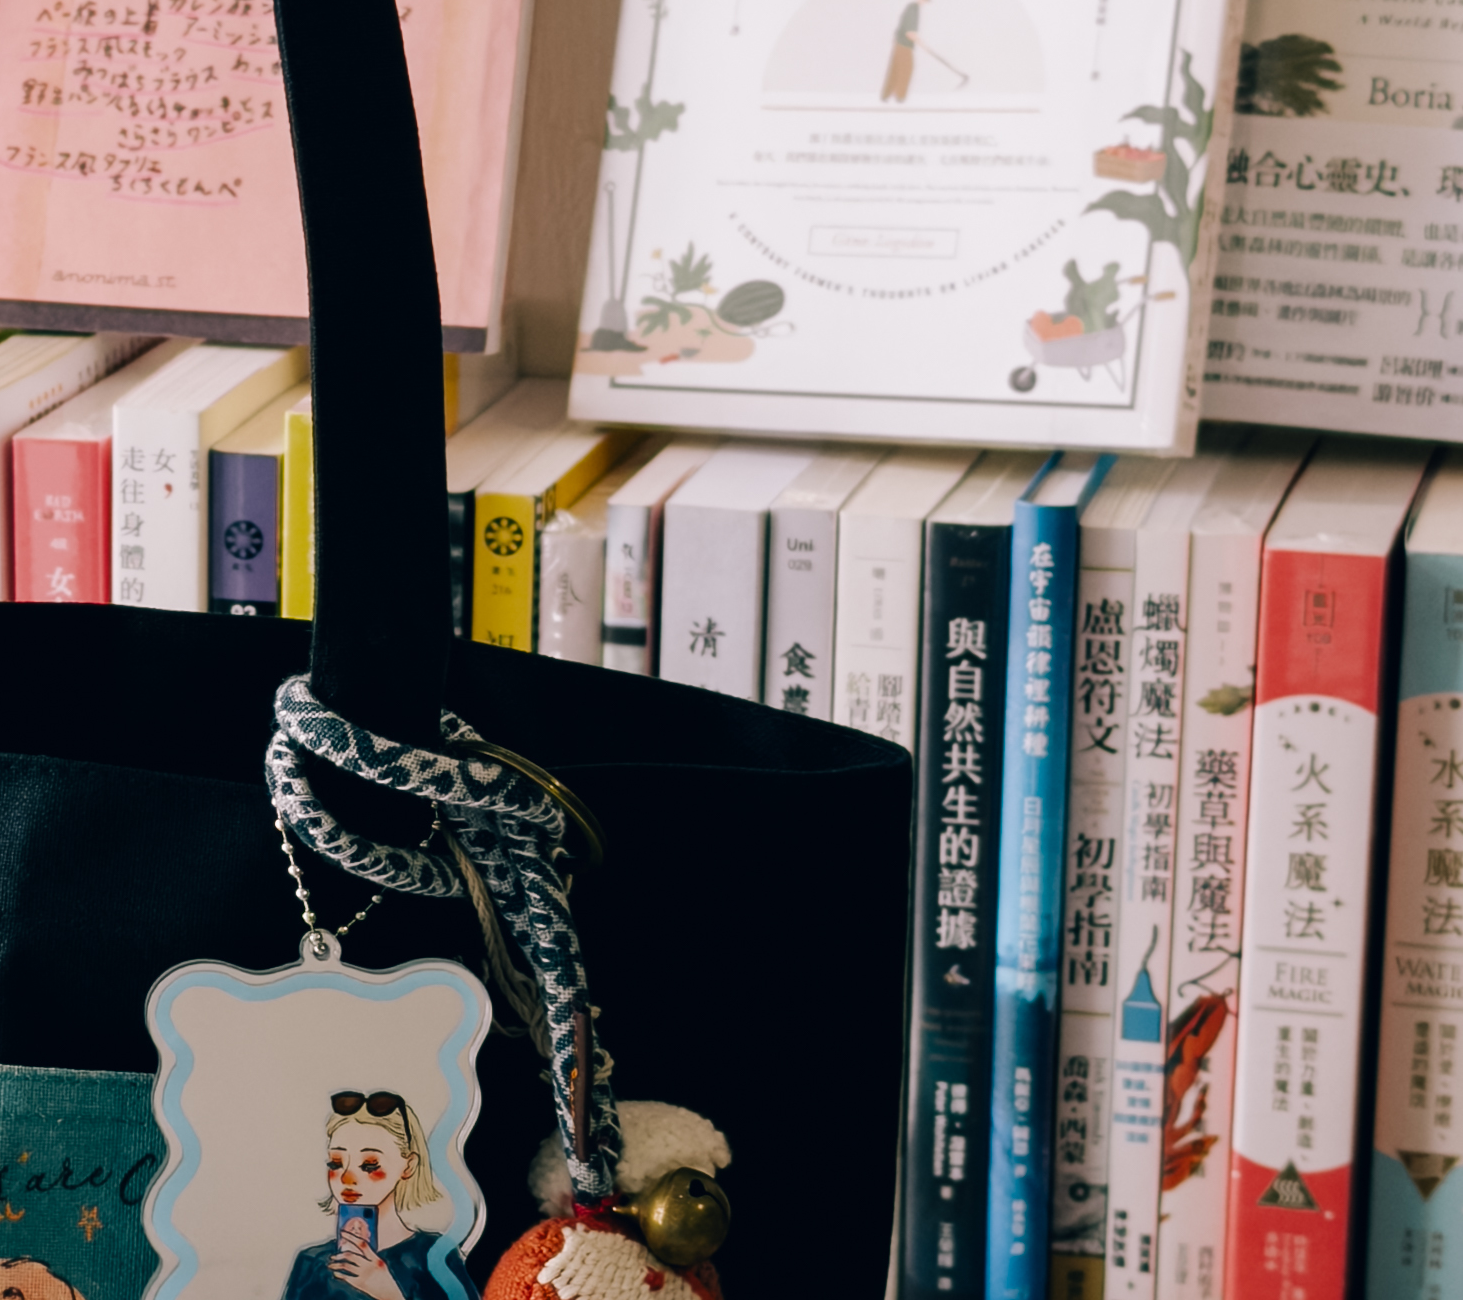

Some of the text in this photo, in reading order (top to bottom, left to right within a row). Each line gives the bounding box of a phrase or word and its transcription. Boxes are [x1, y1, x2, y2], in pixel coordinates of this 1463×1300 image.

[1368, 76, 1454, 111] Boria
[119, 446, 146, 604] 走往身體的
[688, 616, 726, 660] 清
[1077, 597, 1126, 756] 盧恩符文
[1131, 592, 1187, 760] 蠟燭魔法
[935, 616, 988, 951] 與自然共生的證據
[1139, 781, 1175, 906] 初學指南
[1185, 748, 1239, 953] 藥草與魔法
[1283, 753, 1333, 942] 火系魔法
[1421, 748, 1463, 938] 水系魔法
[1067, 832, 1116, 988] 初學指南
[1275, 962, 1329, 987] FIRE
[1268, 985, 1334, 1005] MAGIC
[25, 1157, 112, 1194] are
